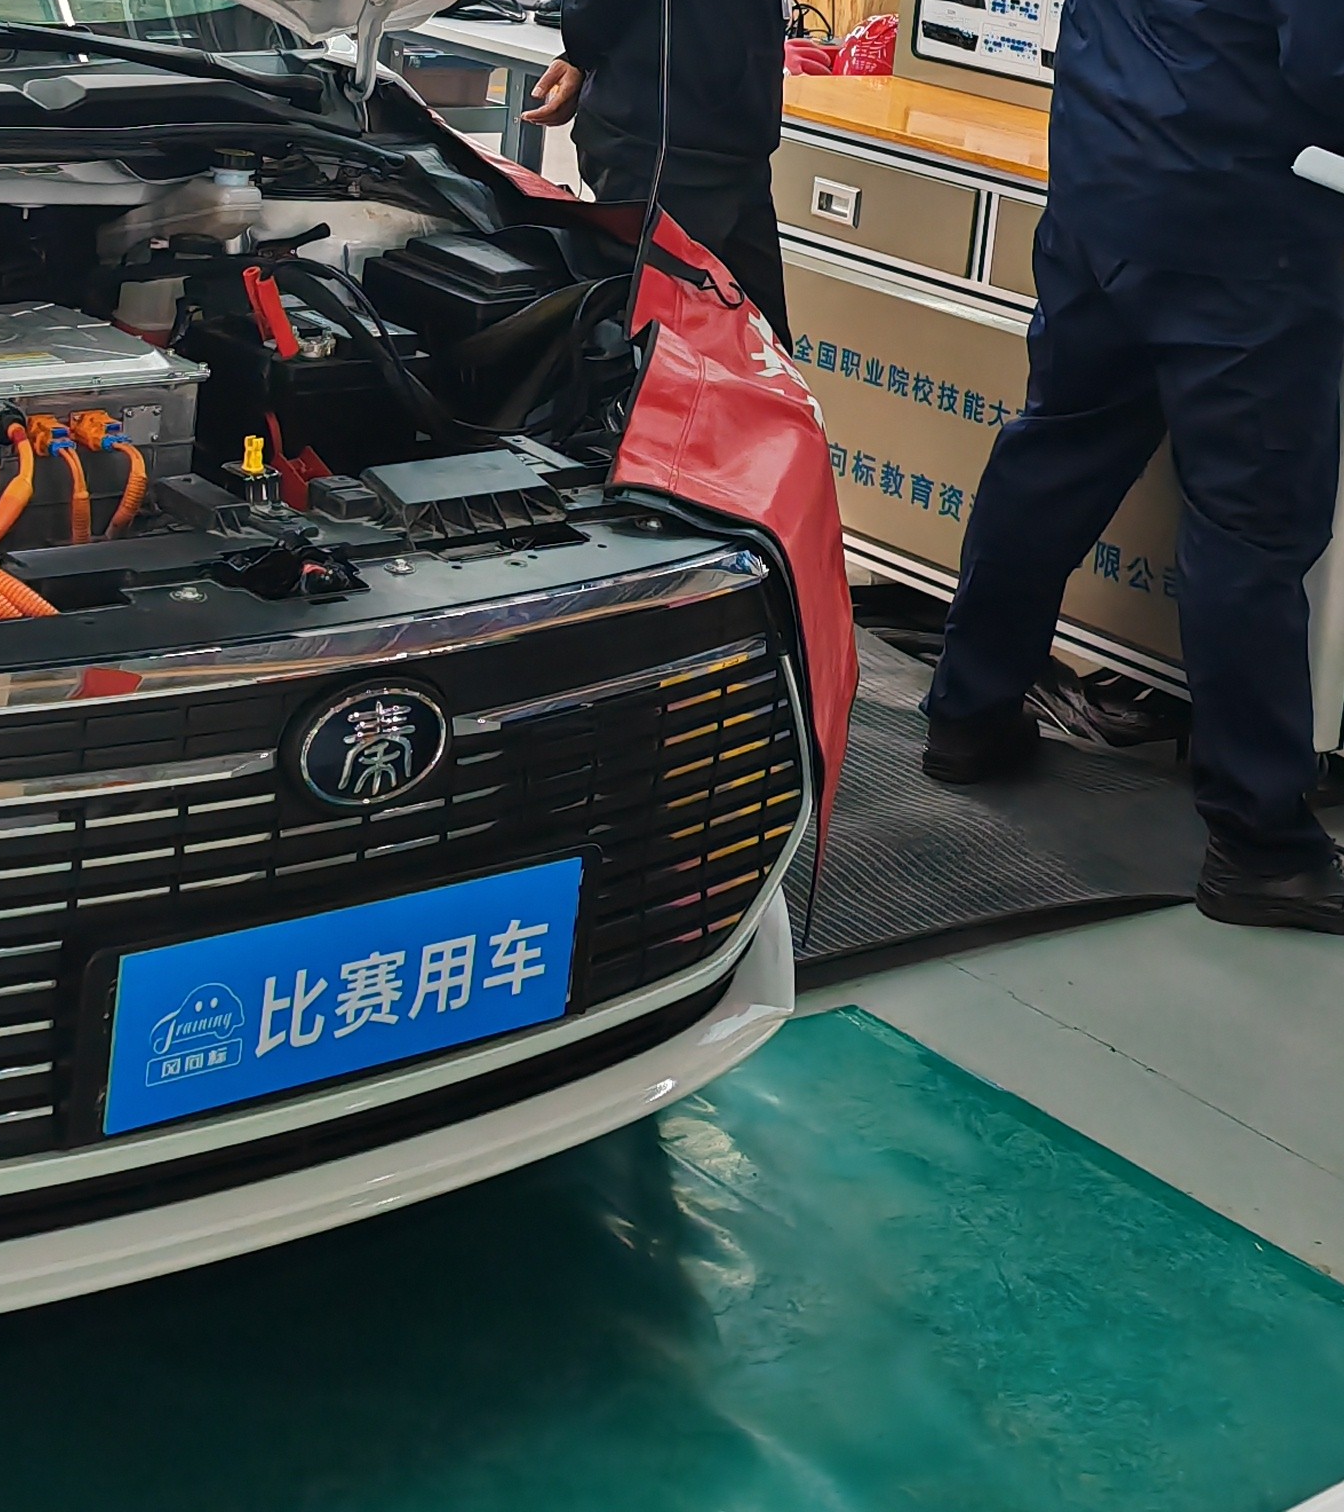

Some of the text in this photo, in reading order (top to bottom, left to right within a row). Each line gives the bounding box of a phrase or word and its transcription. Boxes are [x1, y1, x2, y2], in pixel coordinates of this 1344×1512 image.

[793, 333, 1026, 427] 全国职业院校技能大
[828, 442, 978, 523] 向标教育资
[255, 919, 550, 1058] 比赛用车
